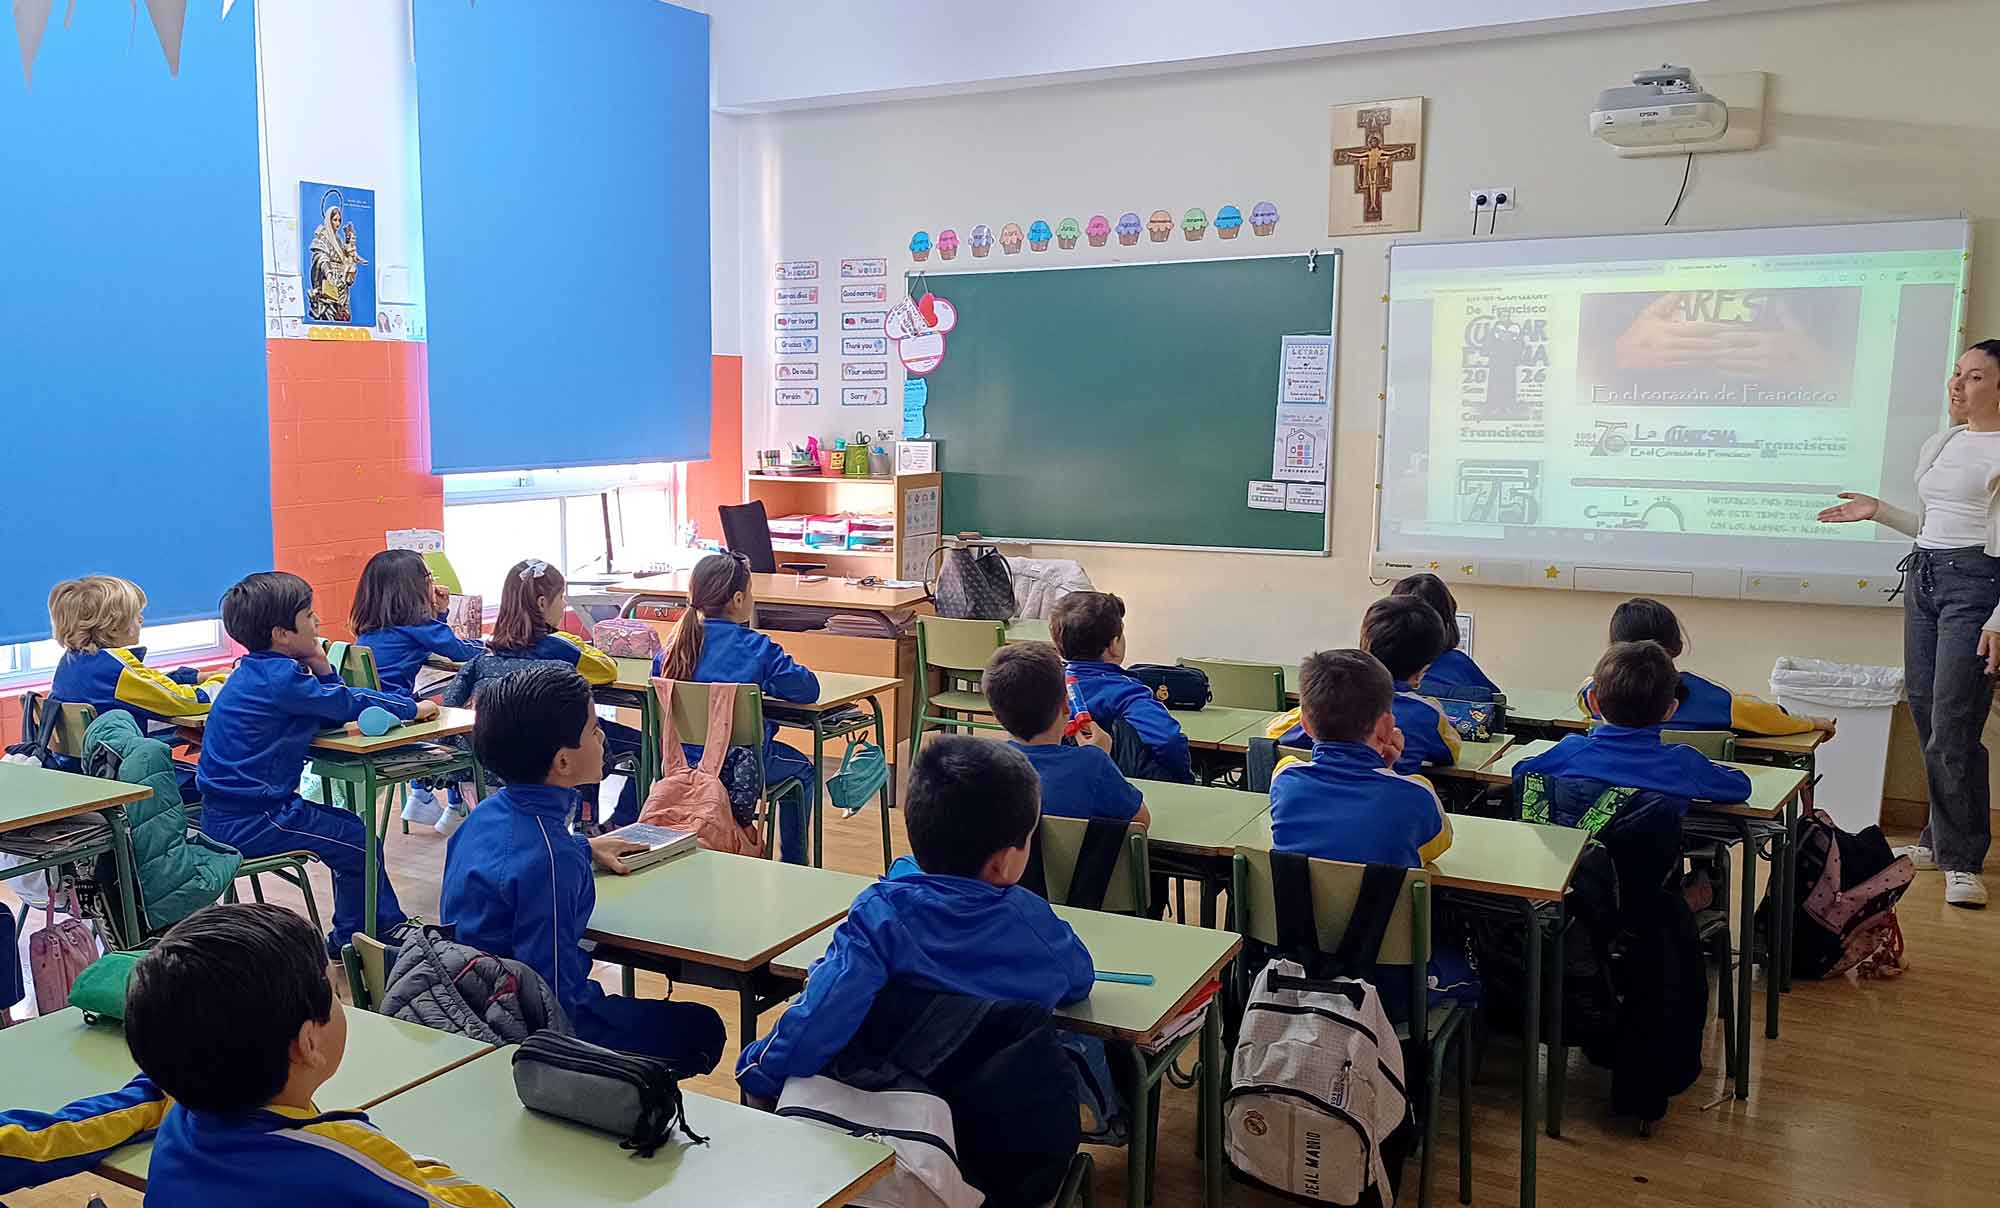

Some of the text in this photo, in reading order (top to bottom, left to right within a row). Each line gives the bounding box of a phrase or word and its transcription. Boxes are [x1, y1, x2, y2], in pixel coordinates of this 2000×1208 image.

[843, 290, 876, 299] Good morning
[1491, 304, 1547, 314] Francisco
[850, 392, 867, 401] Sorry
[1591, 383, 1618, 404] En
[1622, 383, 1638, 401] el
[1714, 383, 1736, 401] de
[1742, 383, 1838, 403] Francisco
[1634, 423, 1657, 440] La
[1303, 1131, 1321, 1196] REAL MADRID
